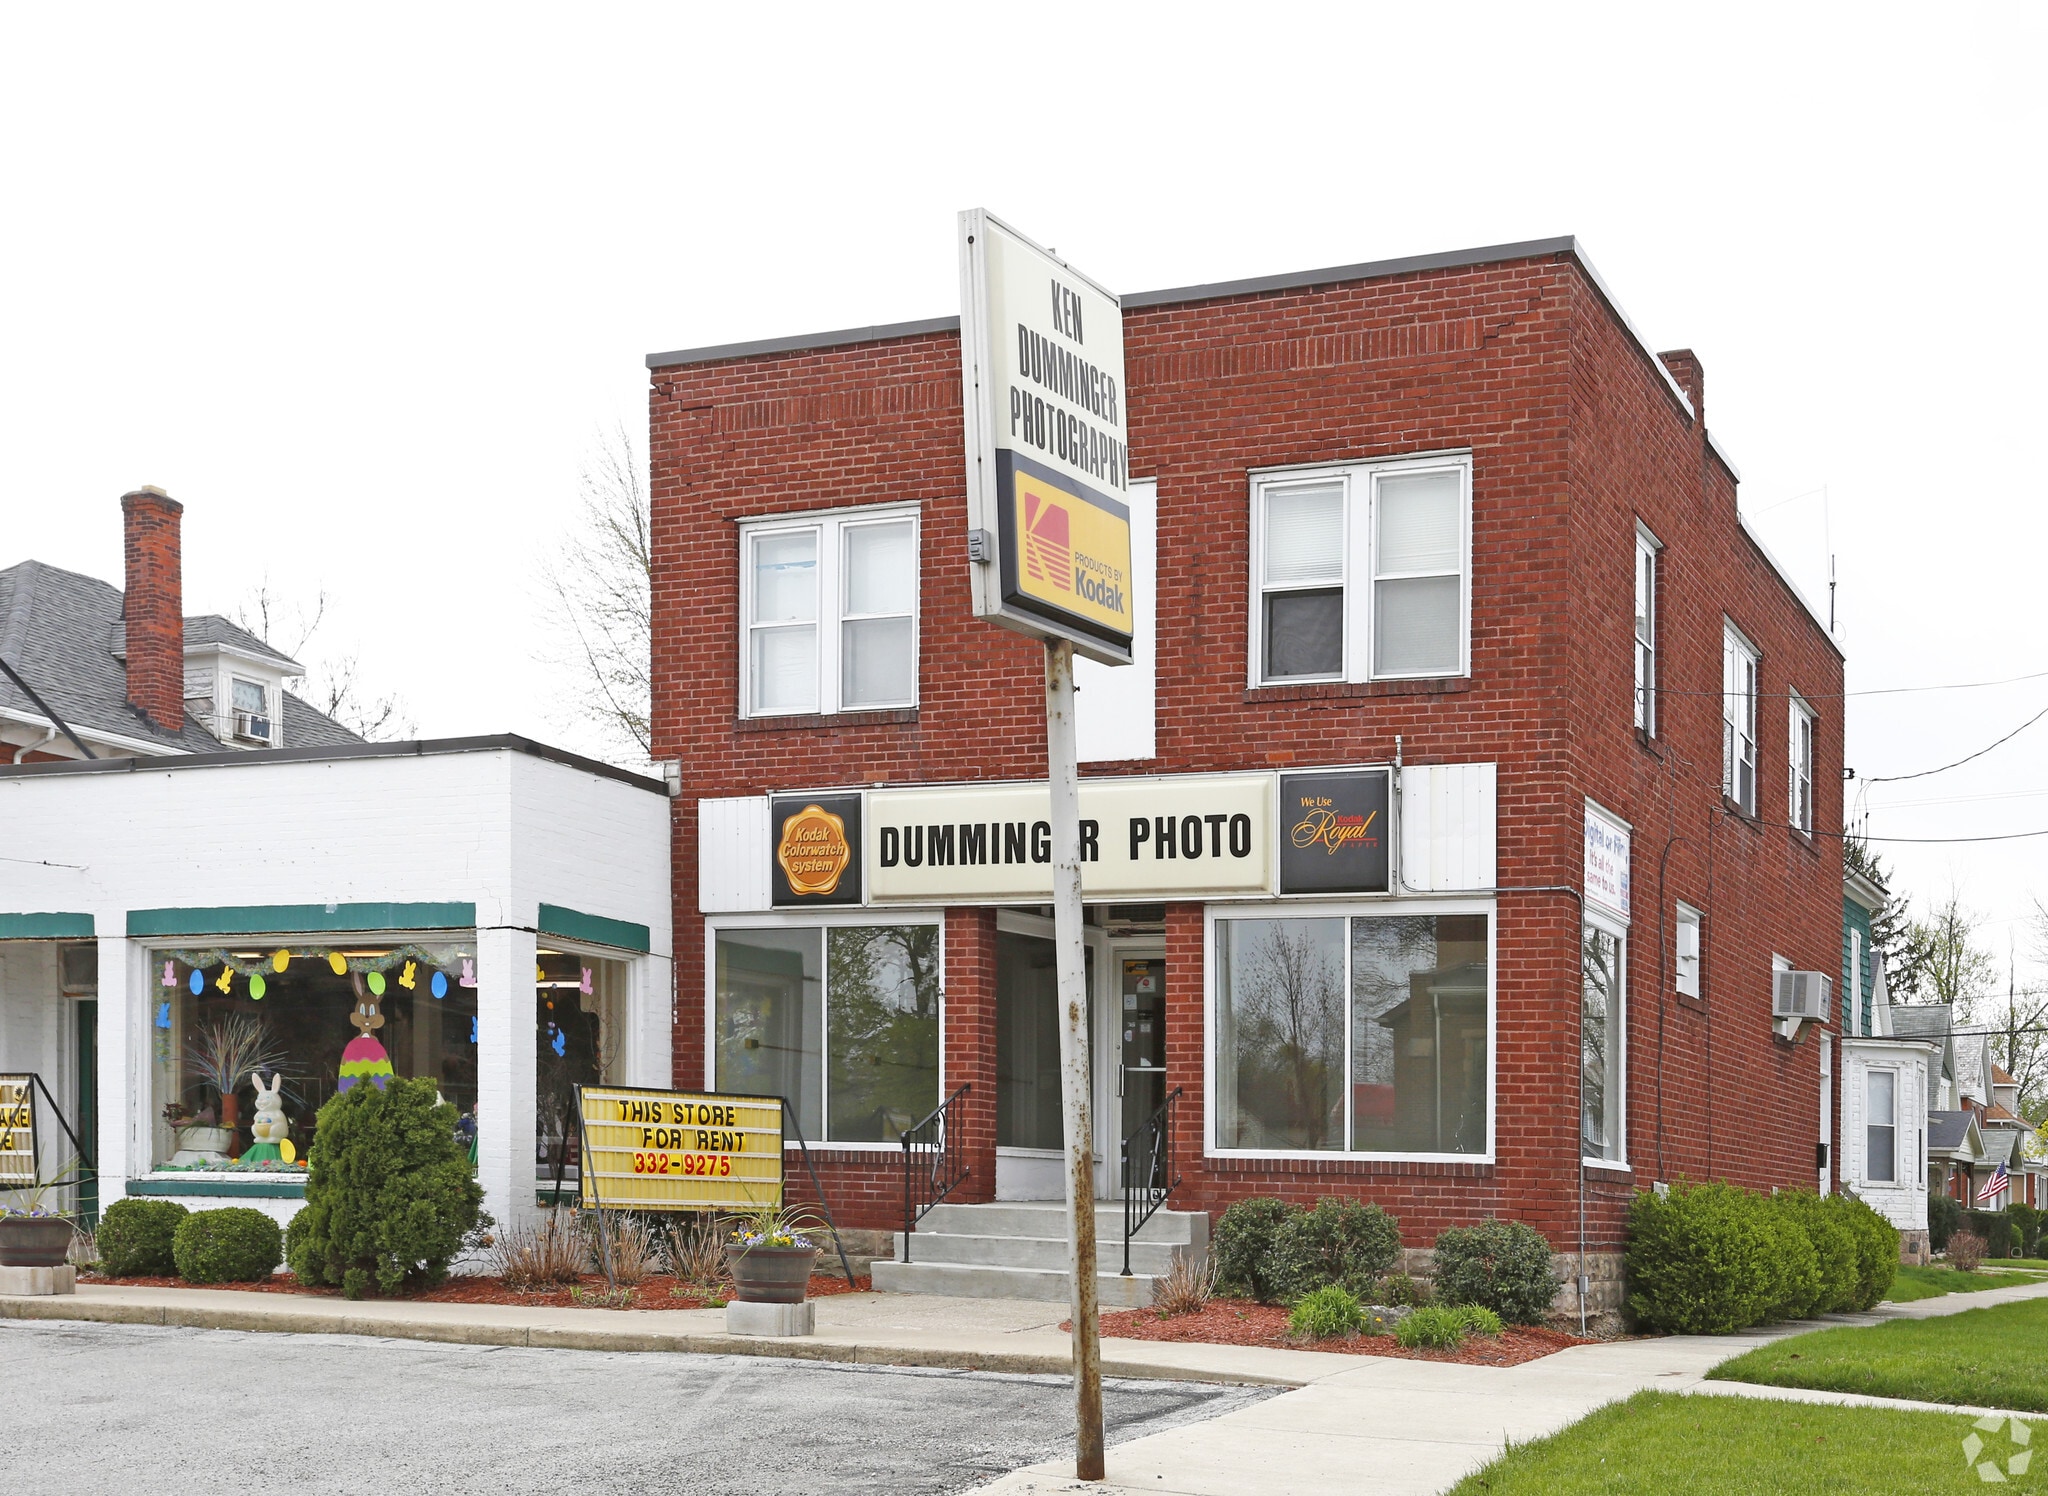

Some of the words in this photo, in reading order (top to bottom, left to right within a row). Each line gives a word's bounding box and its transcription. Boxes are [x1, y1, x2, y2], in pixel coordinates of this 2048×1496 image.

[1051, 278, 1083, 346] KEN
[1018, 322, 1118, 427] DUMMINGER
[1010, 384, 1127, 492] PHOTOGRAPHY
[1074, 551, 1113, 579] PRODUCTS
[1114, 569, 1123, 583] BY
[1075, 566, 1125, 614] Kodak
[1300, 797, 1315, 807] We
[1316, 796, 1333, 807] Use
[1291, 807, 1377, 856] Royal
[1337, 815, 1364, 823] Kodak
[795, 827, 830, 842] Kodak
[880, 819, 1099, 868] DUMMINGR
[1129, 813, 1251, 861] PHOTO
[783, 842, 845, 858] Colorwatch
[791, 859, 834, 875] system
[619, 1100, 662, 1123] THIS
[673, 1103, 735, 1126] STORE
[642, 1127, 682, 1150] FOR
[696, 1129, 744, 1152] RENT
[634, 1152, 731, 1177] 332-9275
